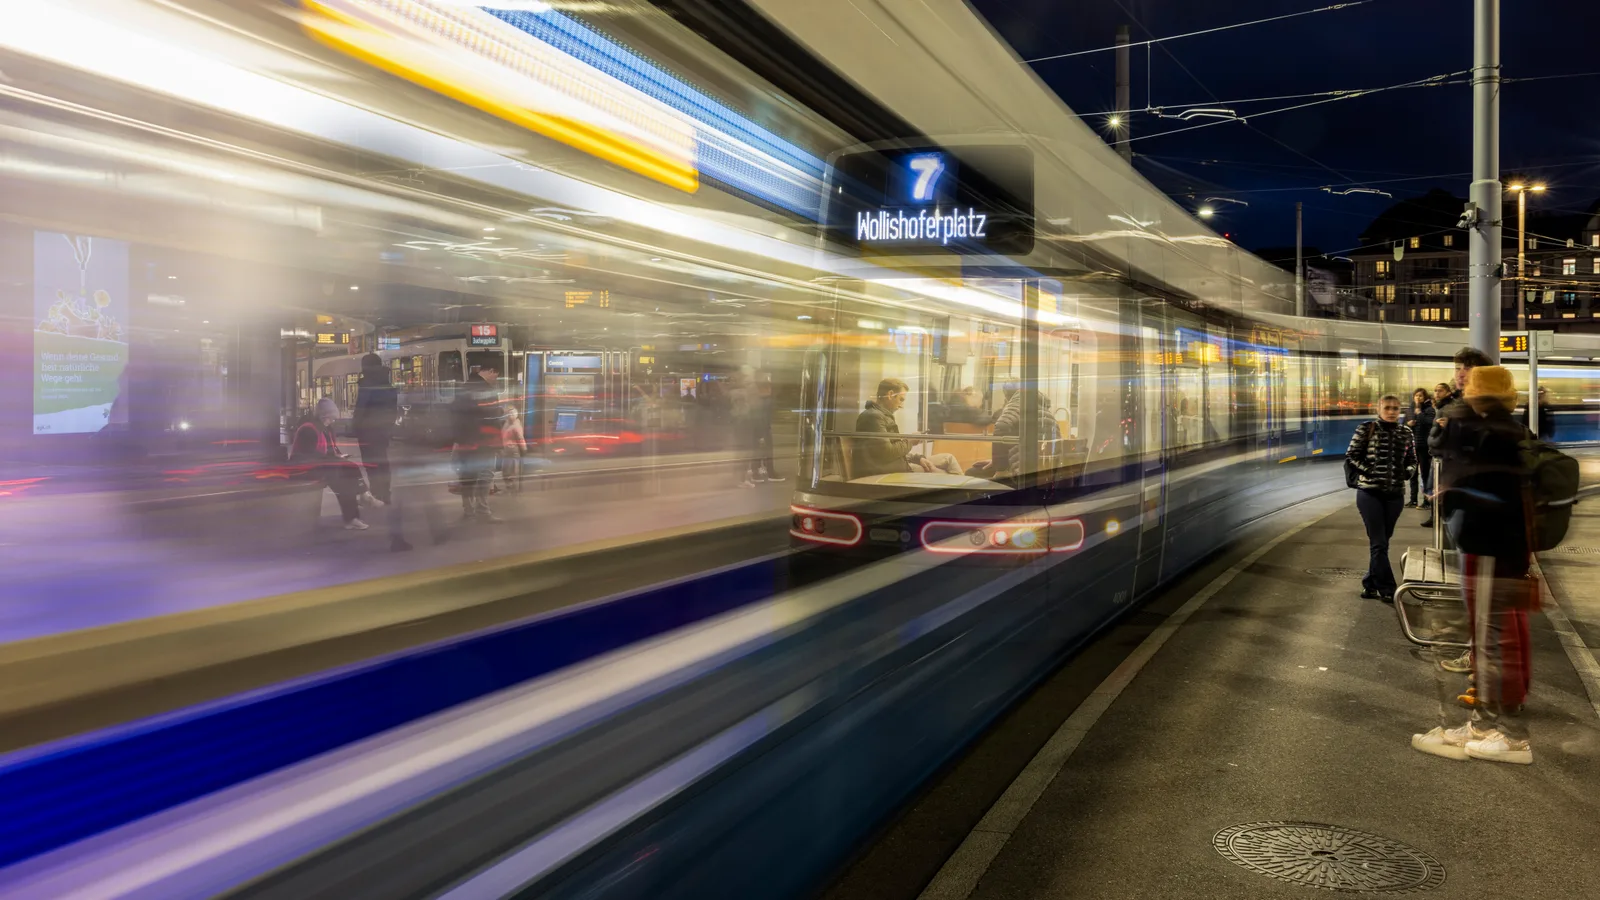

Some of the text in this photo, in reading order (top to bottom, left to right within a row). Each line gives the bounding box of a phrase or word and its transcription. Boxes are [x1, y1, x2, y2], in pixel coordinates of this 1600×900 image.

[910, 157, 944, 200] 7
[857, 207, 986, 244] Wollishoferplatz
[478, 325, 491, 336] 15
[41, 352, 65, 361] Wenn
[67, 352, 88, 361] deine
[41, 373, 63, 383] Wege
